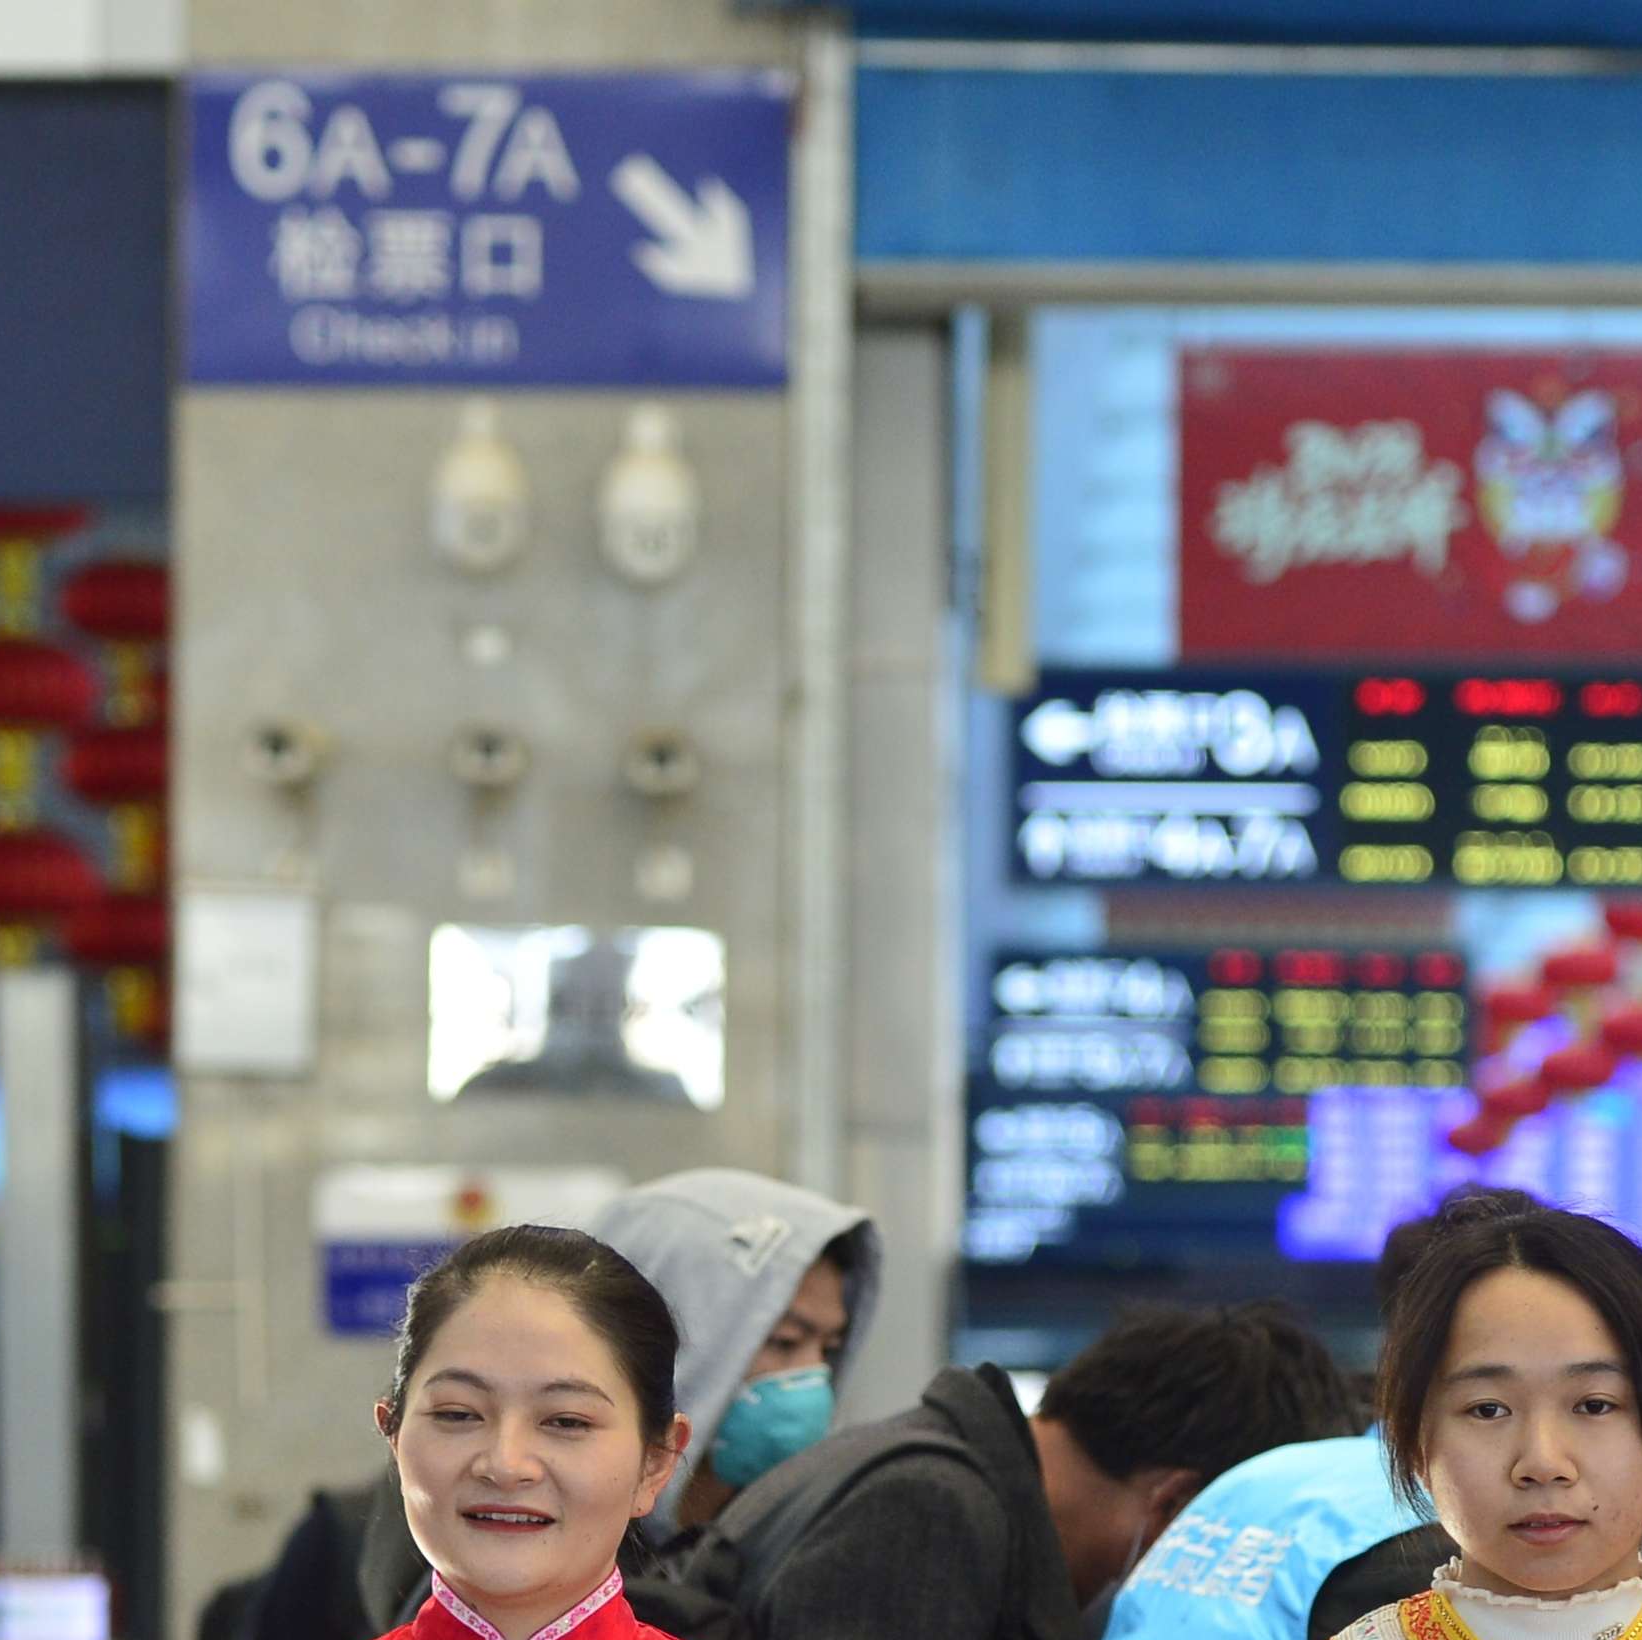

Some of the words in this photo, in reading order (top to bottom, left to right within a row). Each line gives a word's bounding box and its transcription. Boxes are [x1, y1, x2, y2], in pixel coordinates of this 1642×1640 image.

[228, 79, 581, 202] 6A-7A
[269, 205, 544, 301] 检票口
